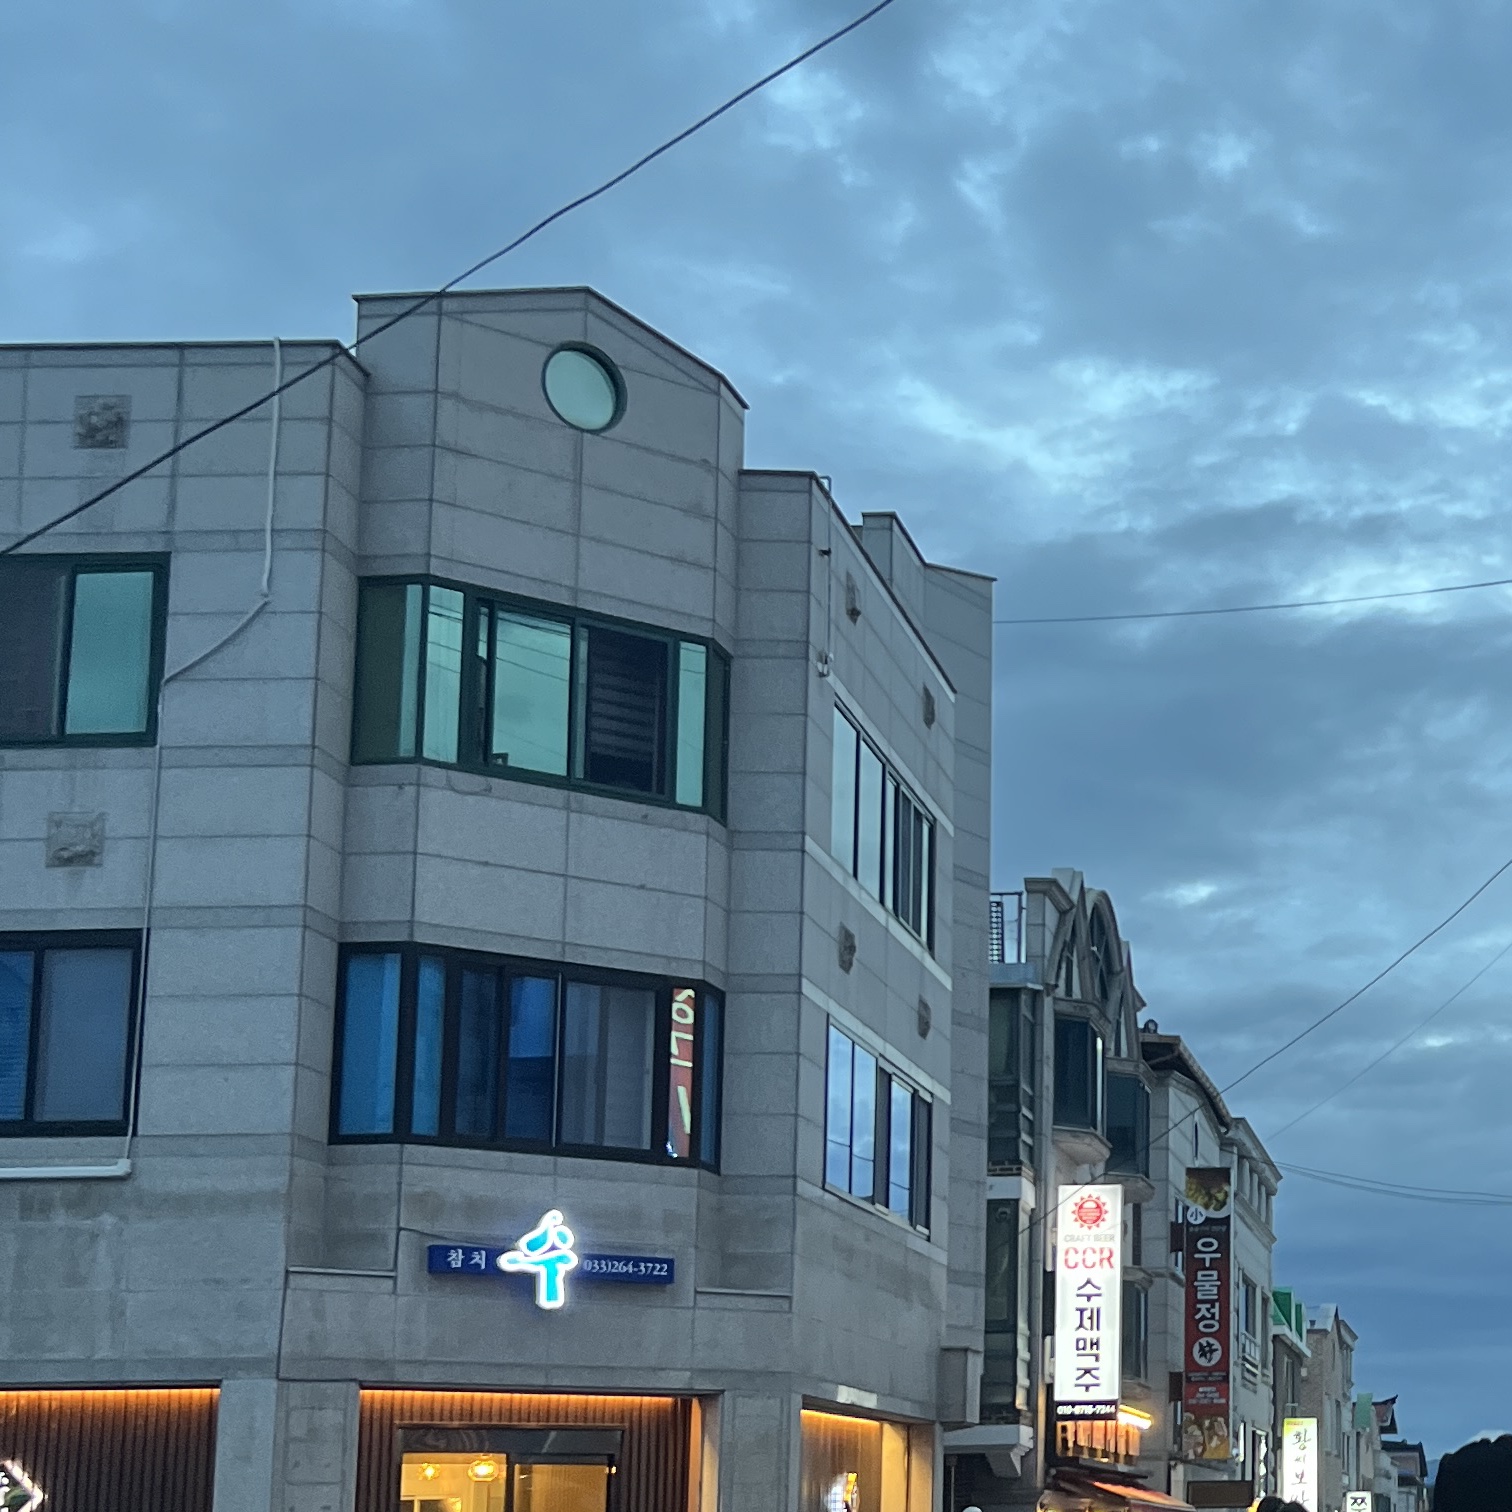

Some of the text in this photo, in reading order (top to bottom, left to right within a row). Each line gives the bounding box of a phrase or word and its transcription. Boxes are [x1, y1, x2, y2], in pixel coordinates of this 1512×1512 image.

[446, 1249, 486, 1270] 참치
[1064, 1247, 1114, 1269] CCR
[1194, 1237, 1221, 1333] 우물정
[1075, 1277, 1102, 1393] 수제맥주
